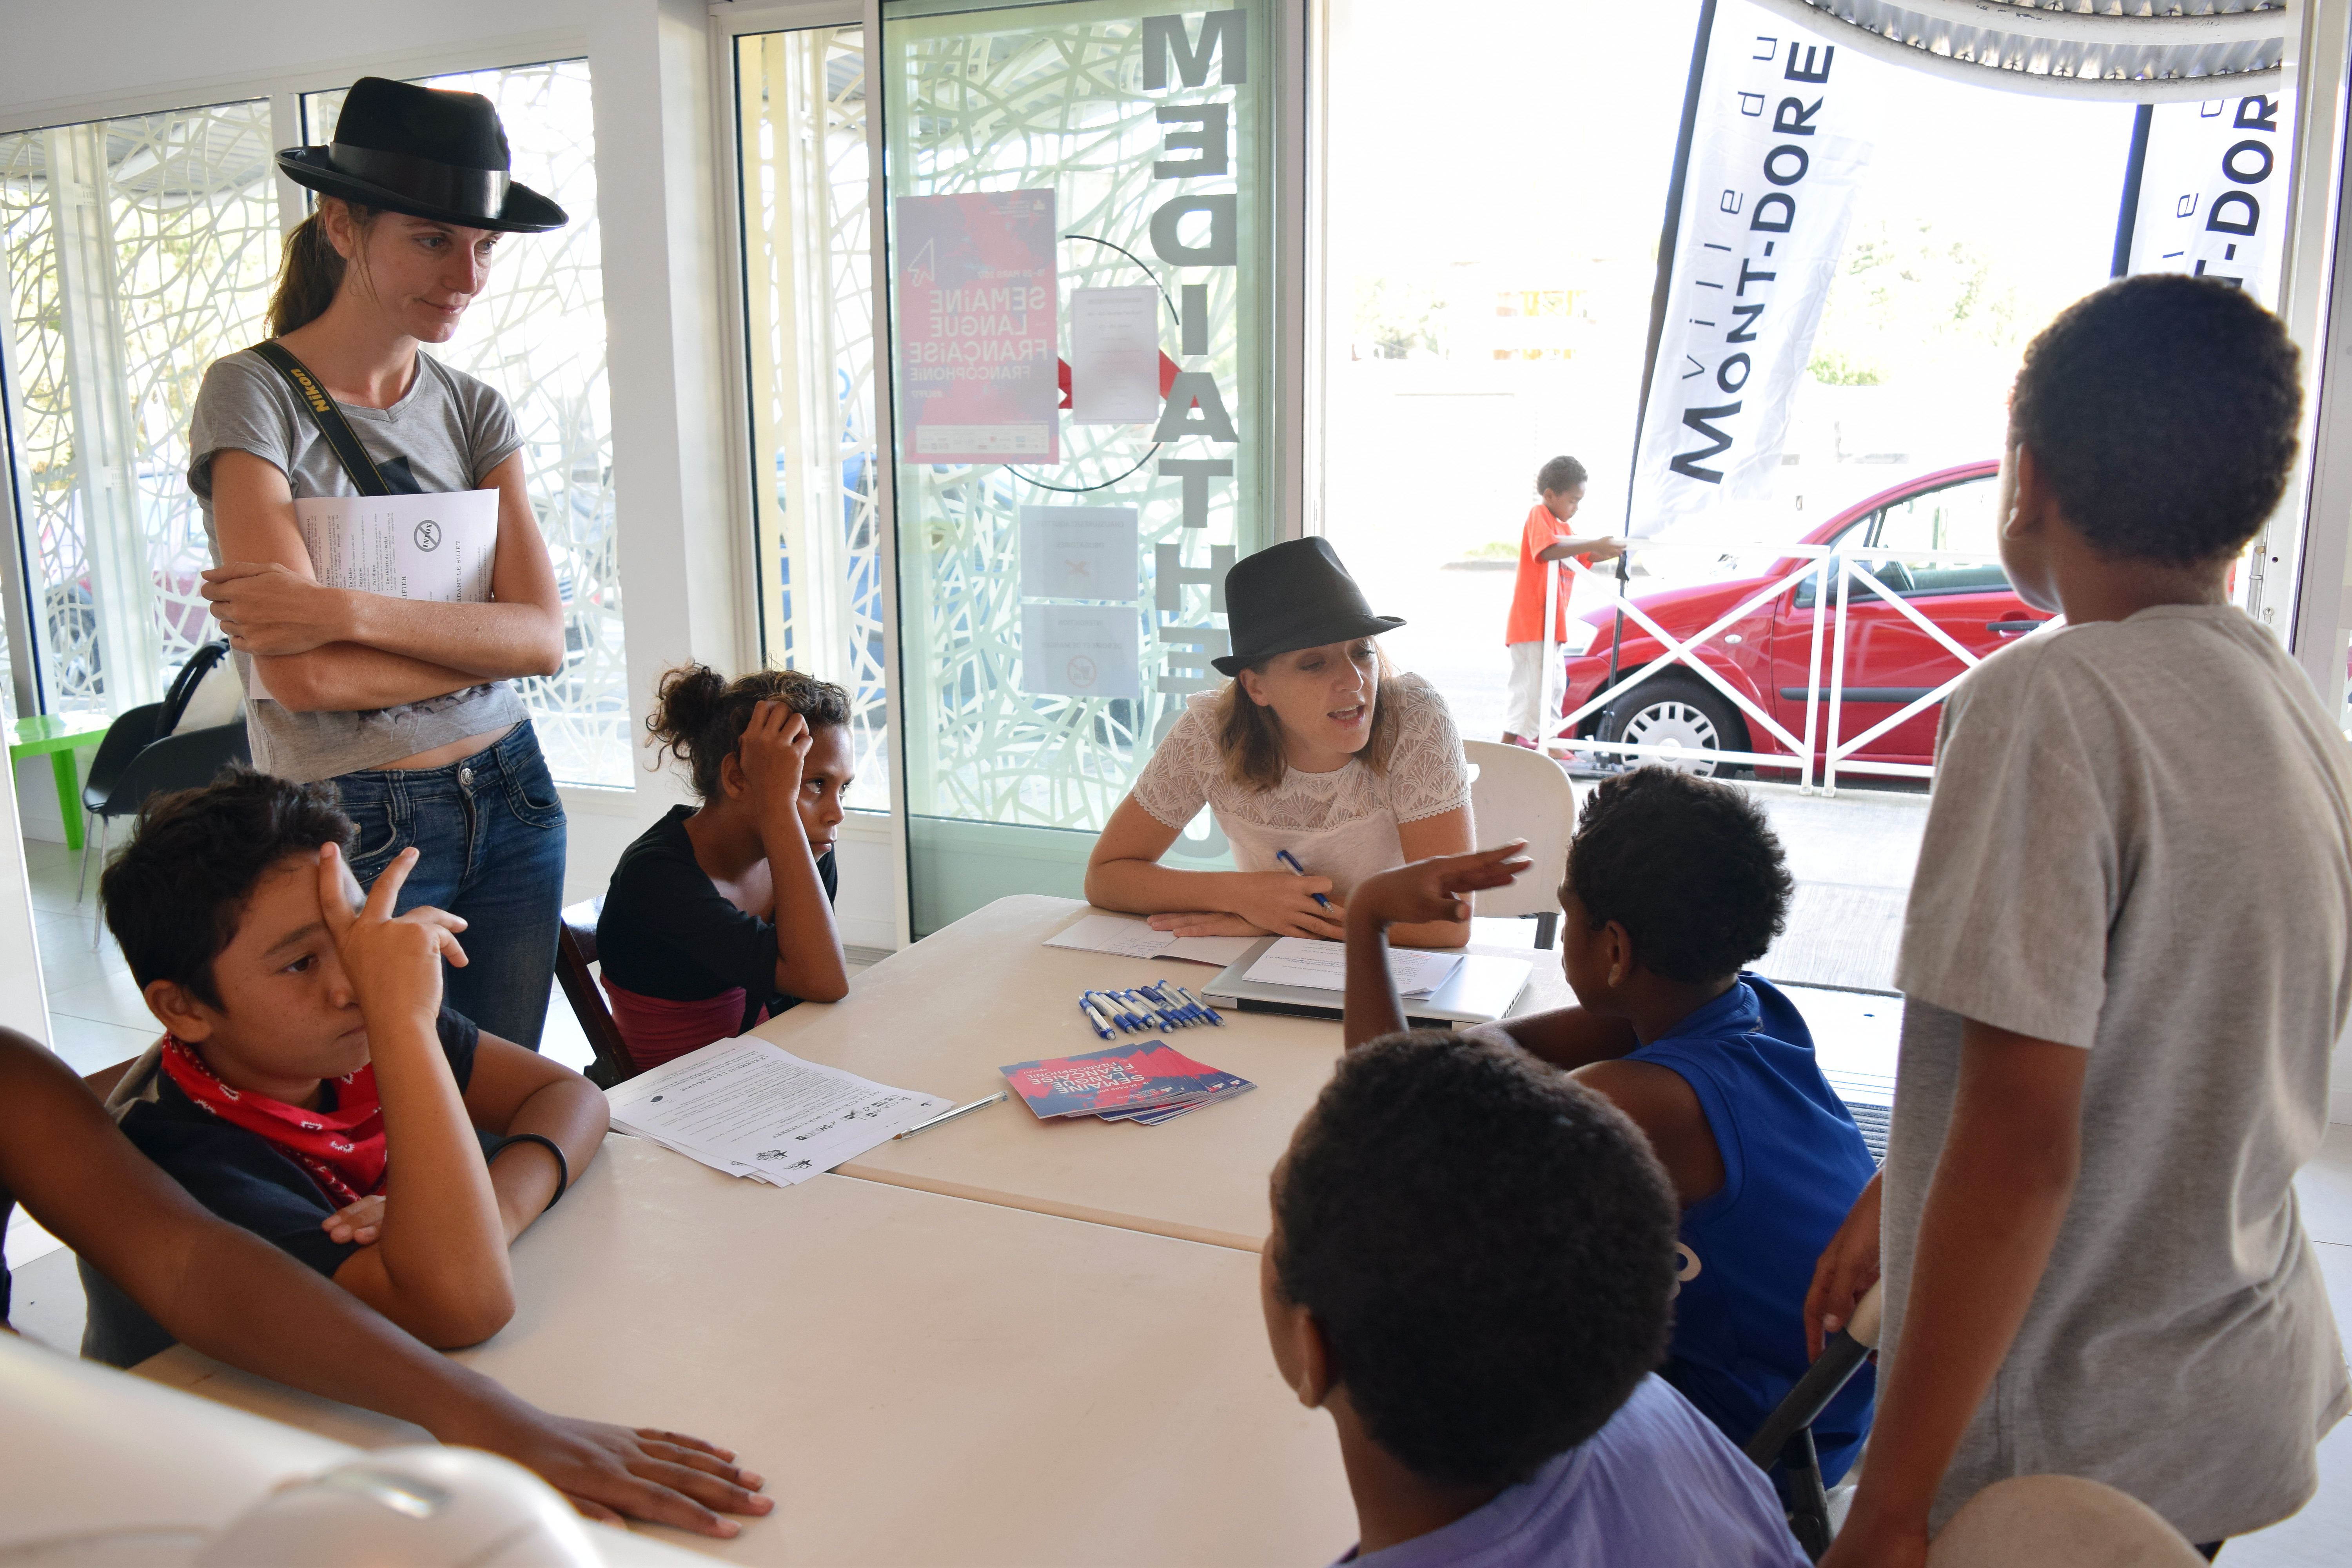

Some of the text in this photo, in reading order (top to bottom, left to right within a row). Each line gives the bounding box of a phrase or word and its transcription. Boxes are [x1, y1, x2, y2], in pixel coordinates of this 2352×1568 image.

[1737, 36, 1778, 118] du
[290, 368, 329, 413] Nikon
[423, 523, 432, 548] INTOX
[456, 566, 461, 575] LE
[726, 1059, 761, 1073] SERMENT
[679, 1080, 708, 1092] SOURIS
[1049, 1071, 1127, 1088] LANGUE
[831, 1100, 860, 1112] SURVIE
[769, 1122, 809, 1138] INTERNET
